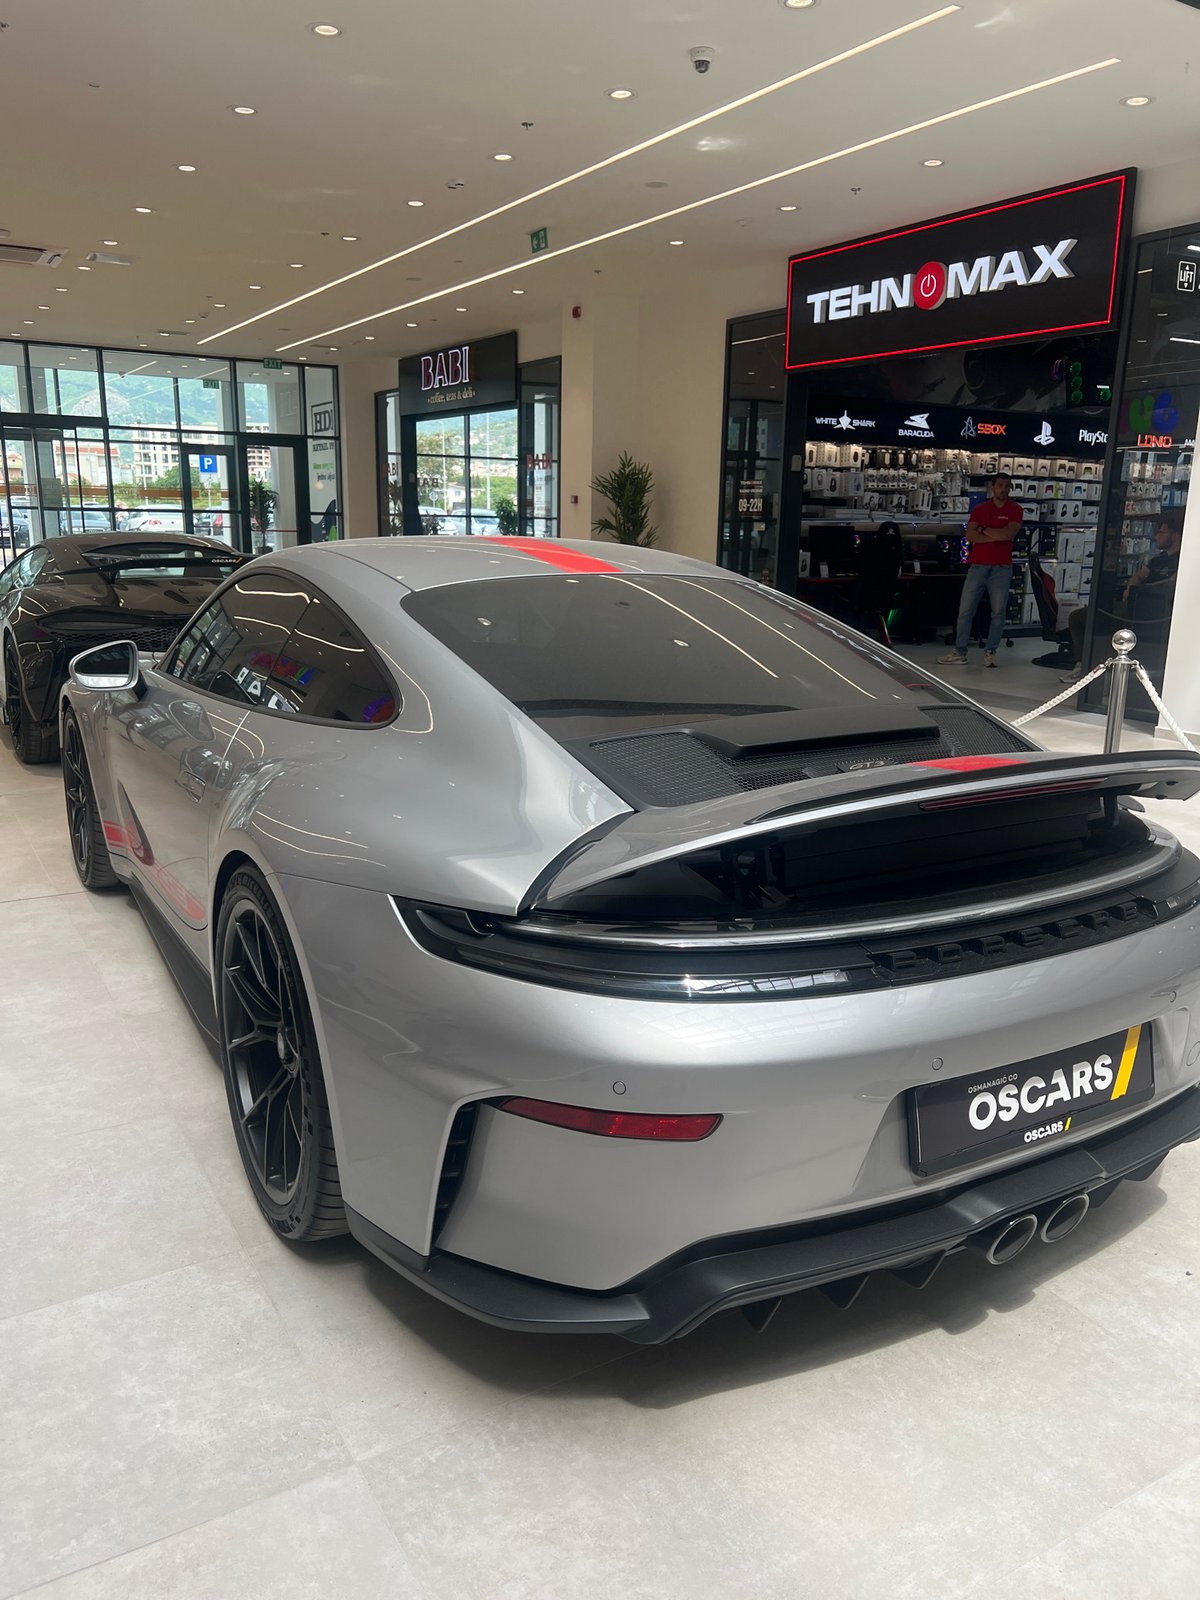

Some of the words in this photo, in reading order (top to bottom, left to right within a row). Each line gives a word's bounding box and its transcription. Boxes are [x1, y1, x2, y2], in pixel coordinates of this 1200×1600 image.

[807, 238, 1078, 324] TEHNOMAX
[1180, 270, 1194, 283] LIFT
[264, 359, 281, 369] EXIT
[421, 346, 470, 390] BABI
[815, 417, 837, 425] WHITE
[852, 419, 876, 428] SHARK
[977, 423, 1007, 435] SBOX
[898, 429, 934, 438] BARACUDA
[204, 457, 213, 470] P
[739, 499, 762, 512] 09-22H
[850, 760, 885, 770] GT3
[884, 900, 1139, 971] PORSCHE
[968, 1074, 1007, 1094] OSMANAGIĆ
[1008, 1073, 1018, 1081] CO
[968, 1054, 1113, 1131] OSCARS
[1024, 1120, 1064, 1143] OSCARS
